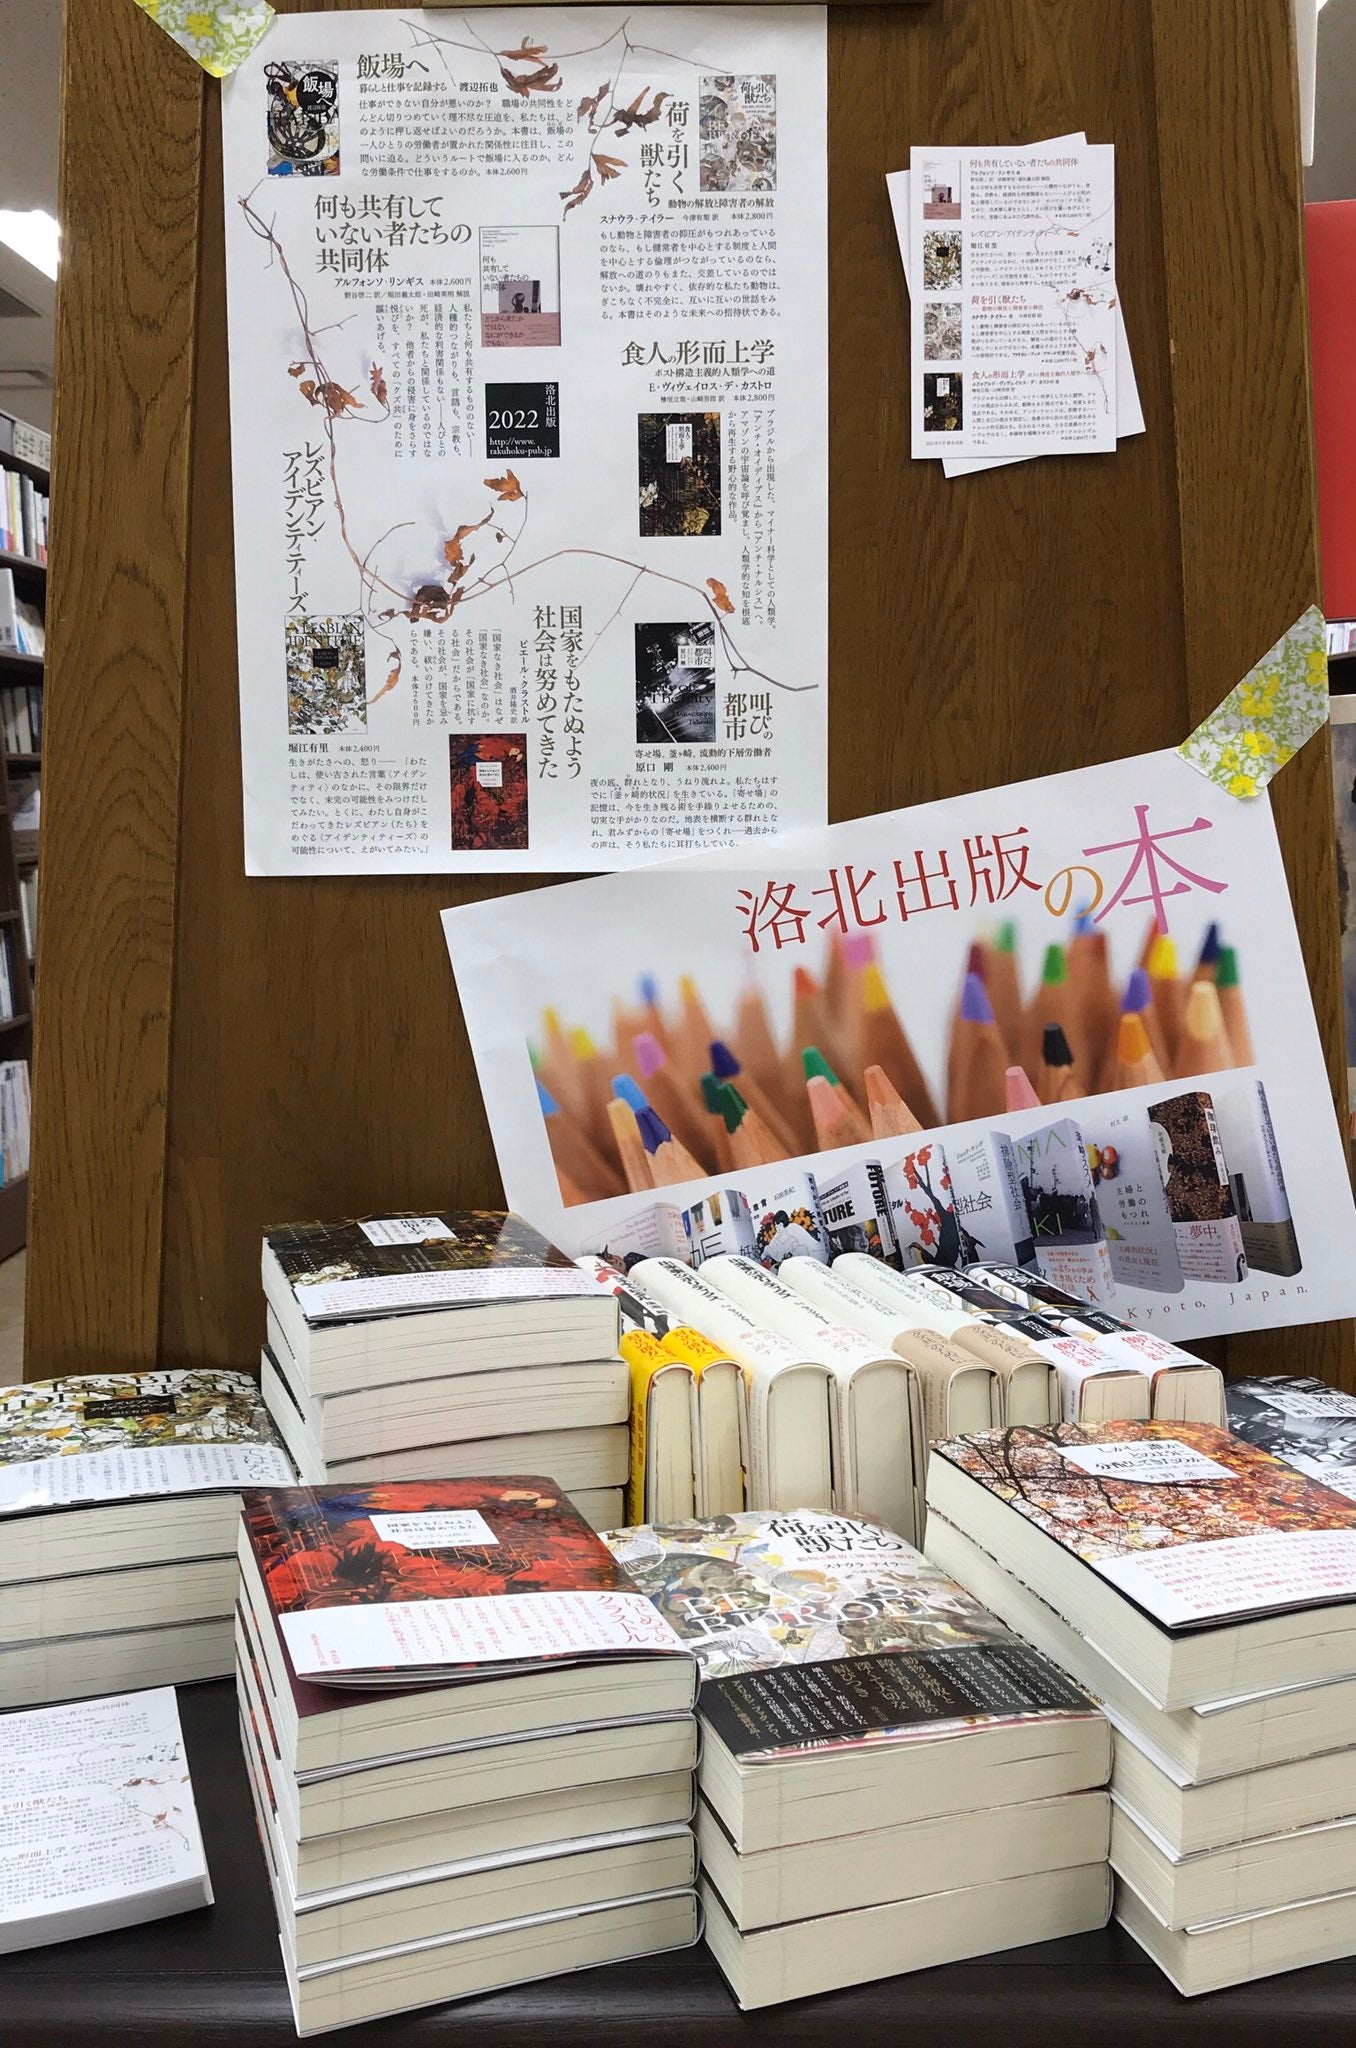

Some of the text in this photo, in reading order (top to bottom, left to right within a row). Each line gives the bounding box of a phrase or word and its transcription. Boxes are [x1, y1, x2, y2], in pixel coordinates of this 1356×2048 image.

[357, 53, 429, 80] 飯場へ
[302, 76, 335, 105] 飯場へ
[359, 82, 499, 93] 暮らしと仕事を記録する 渡辺拓也
[359, 99, 573, 109] 仕事ができない自分が悪いのか？ 職場の共同性をど
[359, 112, 574, 122] んどん切りつめていく理不尽な圧迫を、私たちは、ど
[359, 126, 574, 136] のように押し返せばよいのだろうか。本書は、飯場の
[666, 101, 689, 194] 荷を引く
[360, 153, 574, 164] 問いに迫る。どういうルートで飯場に入るのか、どん
[970, 157, 1078, 168] 何も共有していない者たちの共同体
[361, 166, 481, 177] な労働条件で仕事をするのか。
[640, 143, 664, 208] 獣たち
[314, 194, 444, 220] 何も共有して
[668, 197, 774, 209] 動物の解放と障害者の解放
[600, 214, 674, 224] スナウラ・テイラー
[315, 222, 472, 246] いない者たちの
[600, 228, 776, 240] もし動物と障害者の抑圧がもつれあっている
[600, 241, 776, 253] のなら、もし健常者を中心とする制度と人間
[316, 248, 389, 274] 共同体
[334, 277, 424, 288] アルフォンソ・リンギス
[600, 268, 776, 280] 解放への道のりもまた、交差しているのでは
[600, 281, 780, 293] ないか。壊れやすく、依存的な私たち動物は、
[600, 294, 776, 306] ぎこちなく不完全に、互いに互いの世話をみ
[971, 295, 1027, 305] 荷を引く獣たち
[600, 308, 780, 320] る。本書はそのような未来への招待状である。
[621, 339, 775, 366] 食人の形而上学
[655, 367, 775, 377] ポスト構造主義的人類学への道
[544, 384, 557, 428] 洛北出版
[488, 410, 539, 429] 2022
[489, 437, 535, 448] http://www.
[489, 446, 552, 457] rakuhoku-pub.jp
[282, 451, 309, 613] アイデンティティーズ
[519, 640, 530, 724] ピエール・クラストル
[533, 605, 558, 779] 社会は努めてきた
[560, 605, 585, 780] 国家をもたぬよう
[722, 693, 747, 741] 都市
[750, 693, 773, 740] 叫びの
[288, 742, 329, 754] 堀江有里
[636, 762, 656, 773] 原口
[663, 762, 674, 773] 剛
[291, 807, 428, 817] てみたい。とくに、わたし自身がこ
[735, 804, 1229, 953] 洛北出版の本
[1127, 1284, 1308, 1320] Kyoto, Japan.
[767, 1517, 887, 1538] 荷を引く
[794, 1535, 904, 1554] 獣たち
[596, 1594, 650, 1644] クラストル
[624, 1595, 676, 1645] はじめての
[831, 1663, 869, 1698] 結びつき
[901, 1656, 956, 1705] 動物の解放と
